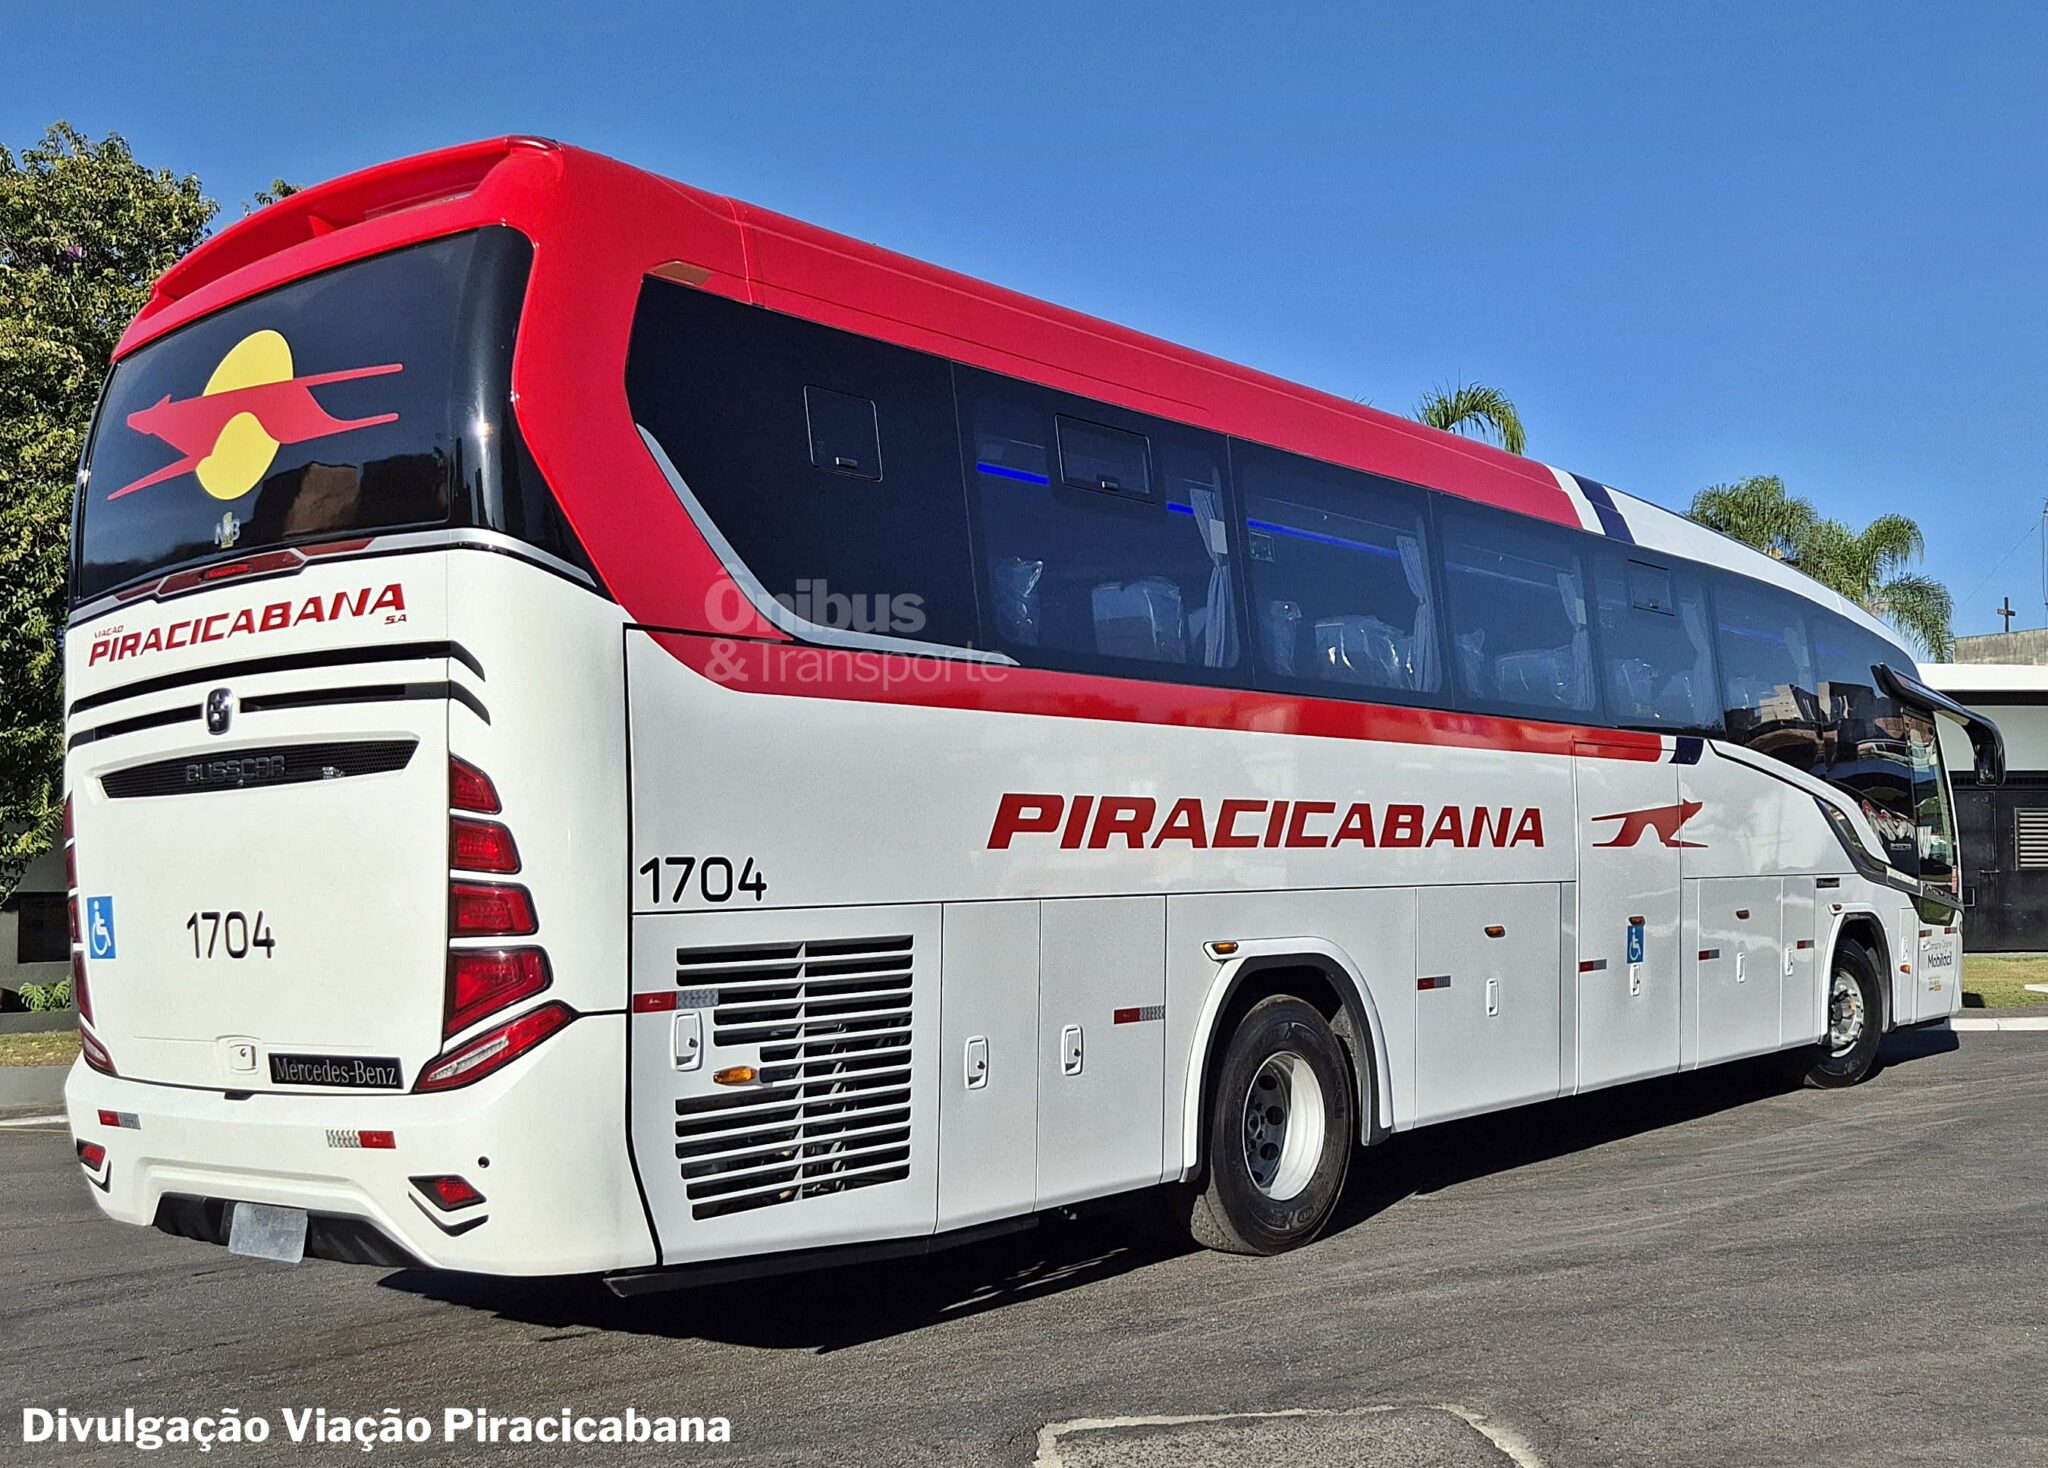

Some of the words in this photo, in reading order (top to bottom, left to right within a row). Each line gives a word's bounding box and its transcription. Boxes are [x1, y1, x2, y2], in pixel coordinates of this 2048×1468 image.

[88, 583, 406, 667] PIRACICABANA
[987, 793, 1545, 850] PIRACICABANA
[640, 856, 767, 903] 1704
[187, 910, 276, 959] 1704
[274, 1057, 397, 1085] Mercedes-Benz
